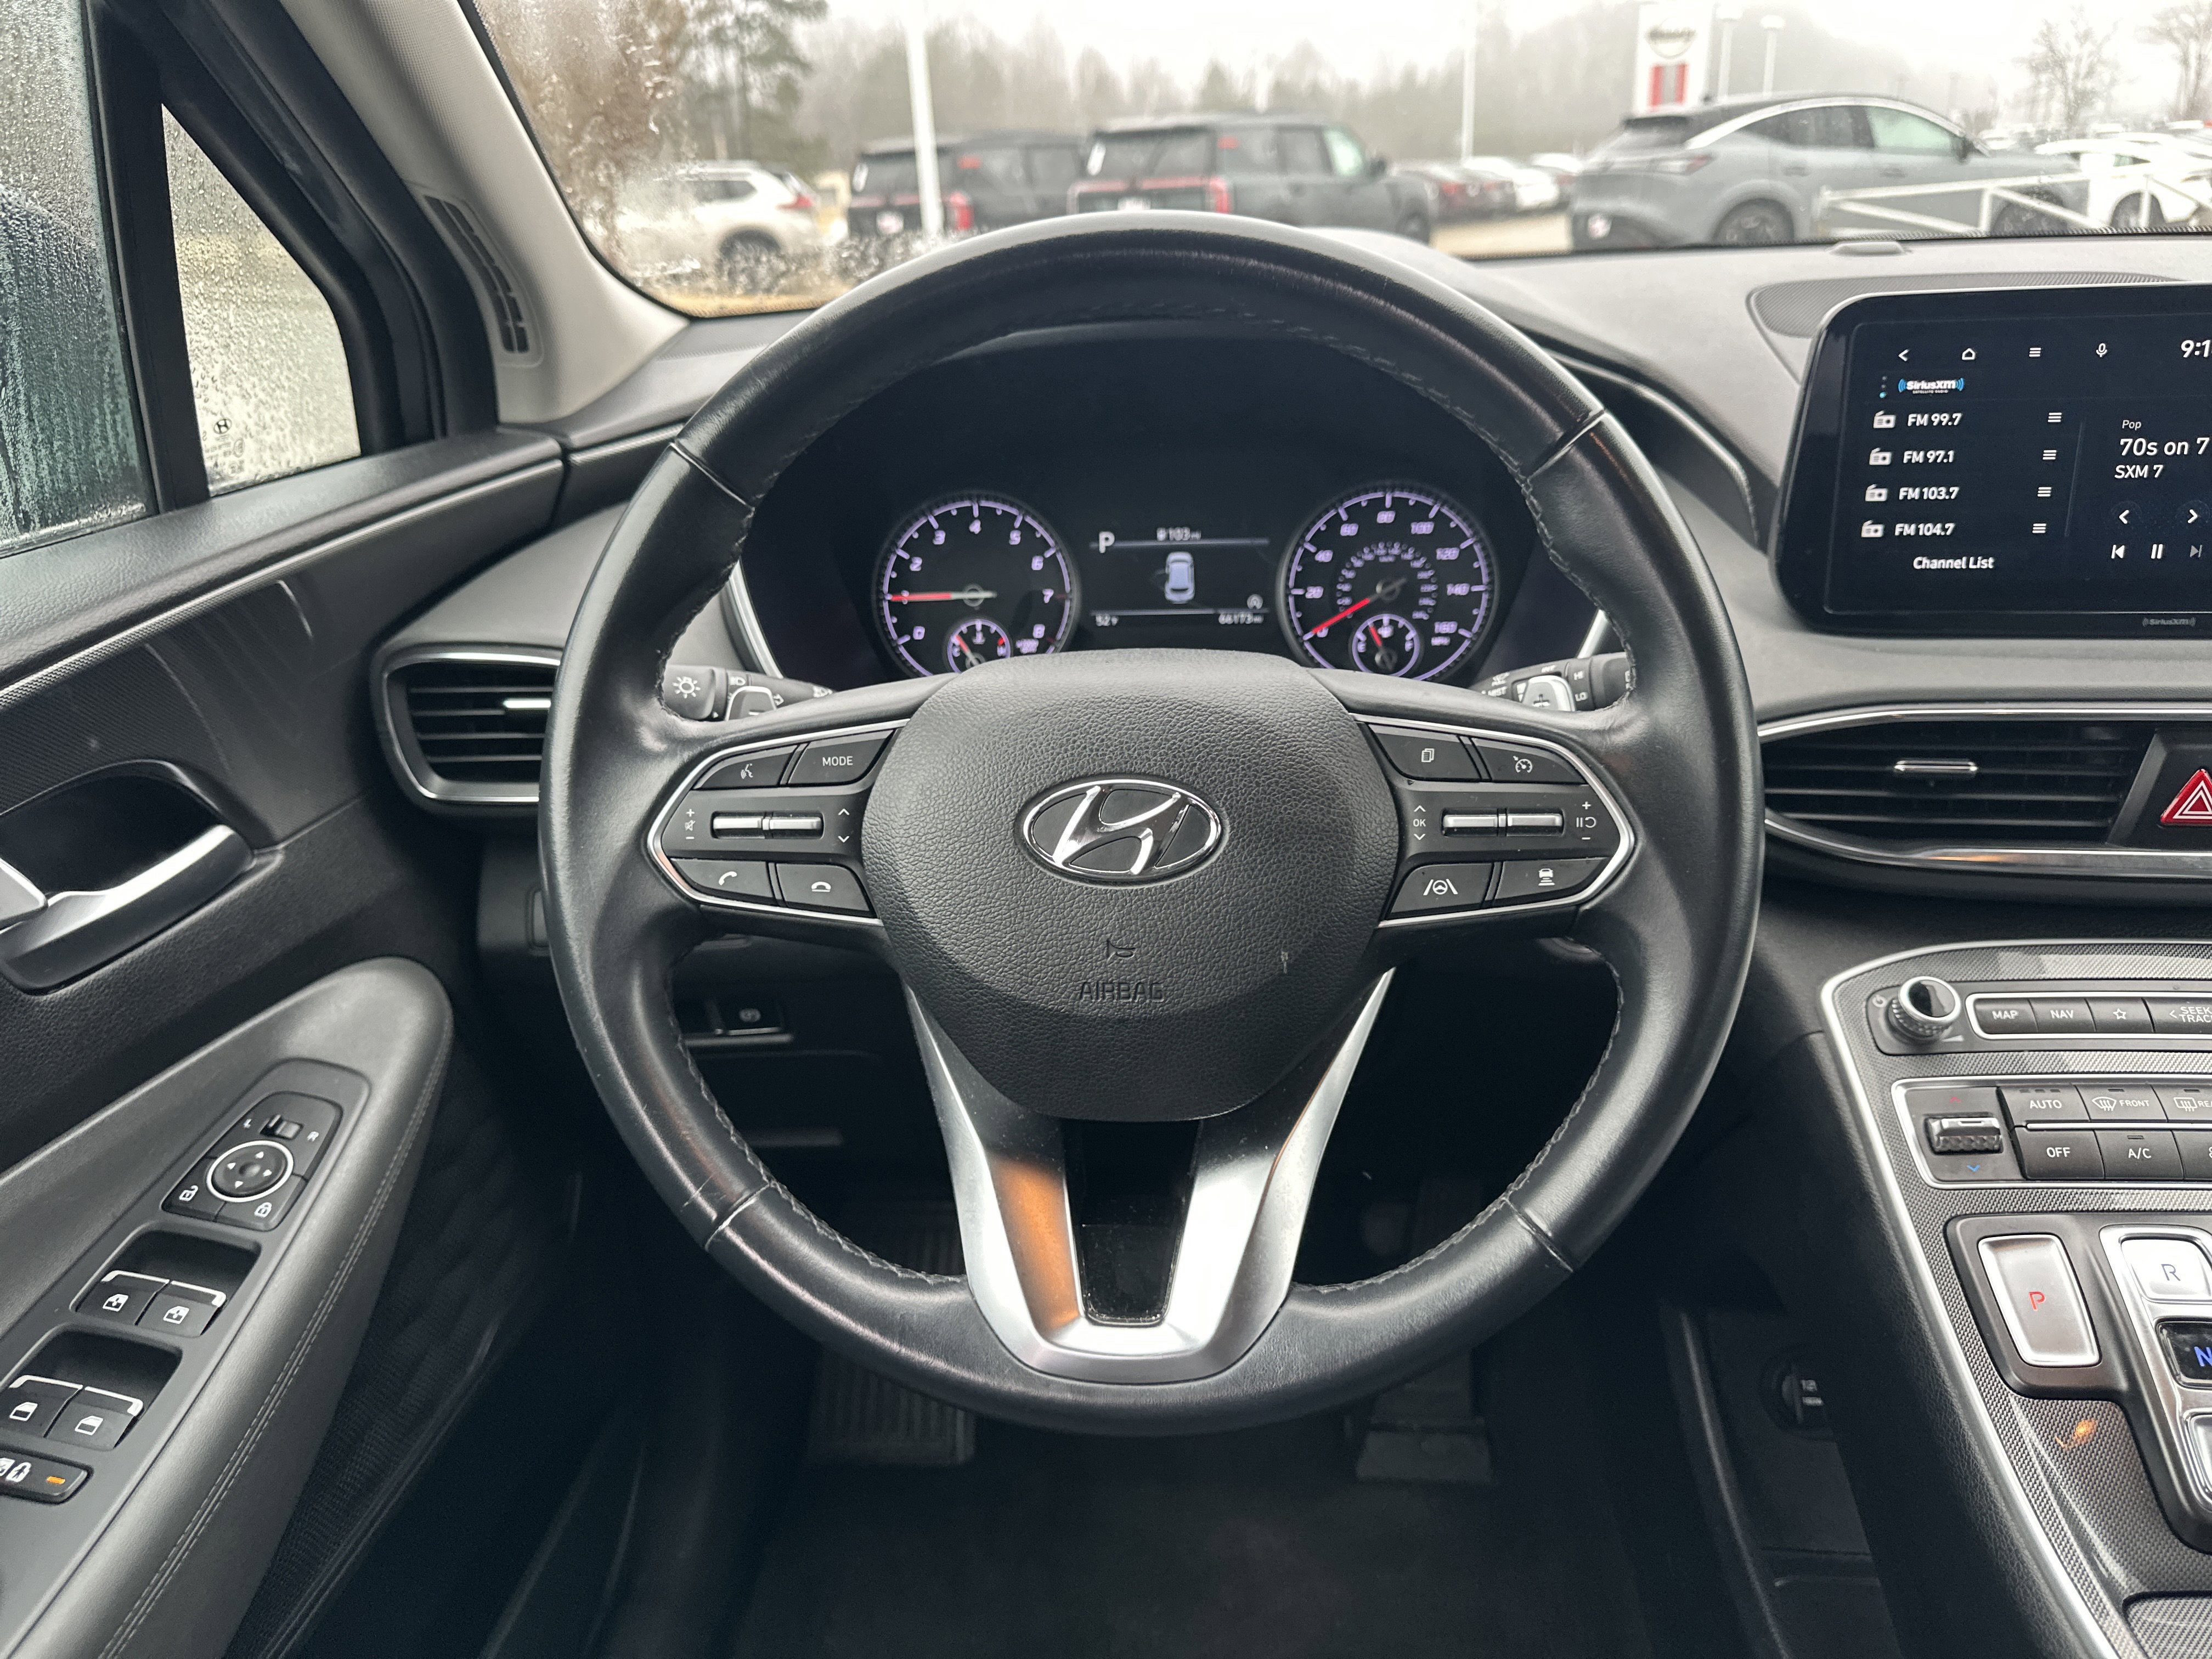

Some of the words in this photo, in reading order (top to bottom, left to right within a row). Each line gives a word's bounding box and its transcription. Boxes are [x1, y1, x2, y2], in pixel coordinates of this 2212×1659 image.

[2181, 340, 2212, 358] 9:1
[1907, 413, 1929, 427] FM
[1931, 413, 1962, 426] 99.7
[2121, 420, 2142, 431] Pop
[2120, 438, 2158, 456] 70s
[2164, 441, 2189, 455] on
[2196, 437, 2210, 455] 7
[1903, 450, 1925, 464] FM
[1927, 450, 1954, 463] 97.1
[2114, 465, 2149, 479] SXM
[2153, 464, 2164, 478] 7
[1899, 487, 1920, 500] FM
[1922, 487, 1960, 500] 103.7
[969, 519, 981, 534] 4
[1894, 523, 1916, 536] FM
[1917, 523, 1955, 536] 104.7
[933, 530, 946, 545] 3
[1009, 530, 1021, 545] 5
[1099, 531, 1115, 554] P
[910, 556, 922, 571] 2
[1913, 556, 1967, 569] Channel
[1968, 556, 1995, 569] List
[1042, 588, 1054, 603] 7
[1573, 670, 1585, 680] HI
[822, 755, 853, 766] MODE
[1413, 818, 1426, 827] OK
[1079, 981, 1165, 1002] AIRBAG
[1992, 1010, 2019, 1020] MAP
[2050, 1009, 2074, 1019] NAV
[2180, 1006, 2212, 1014] SEEK
[2179, 1014, 2212, 1023] TRAC
[2030, 1099, 2062, 1109] AUTO
[2119, 1099, 2149, 1108] FRONT
[2046, 1147, 2070, 1158] OFF
[2128, 1147, 2152, 1160] A/C
[2160, 1263, 2181, 1282] R
[2028, 1291, 2046, 1310] P
[2194, 1346, 2212, 1367] N
